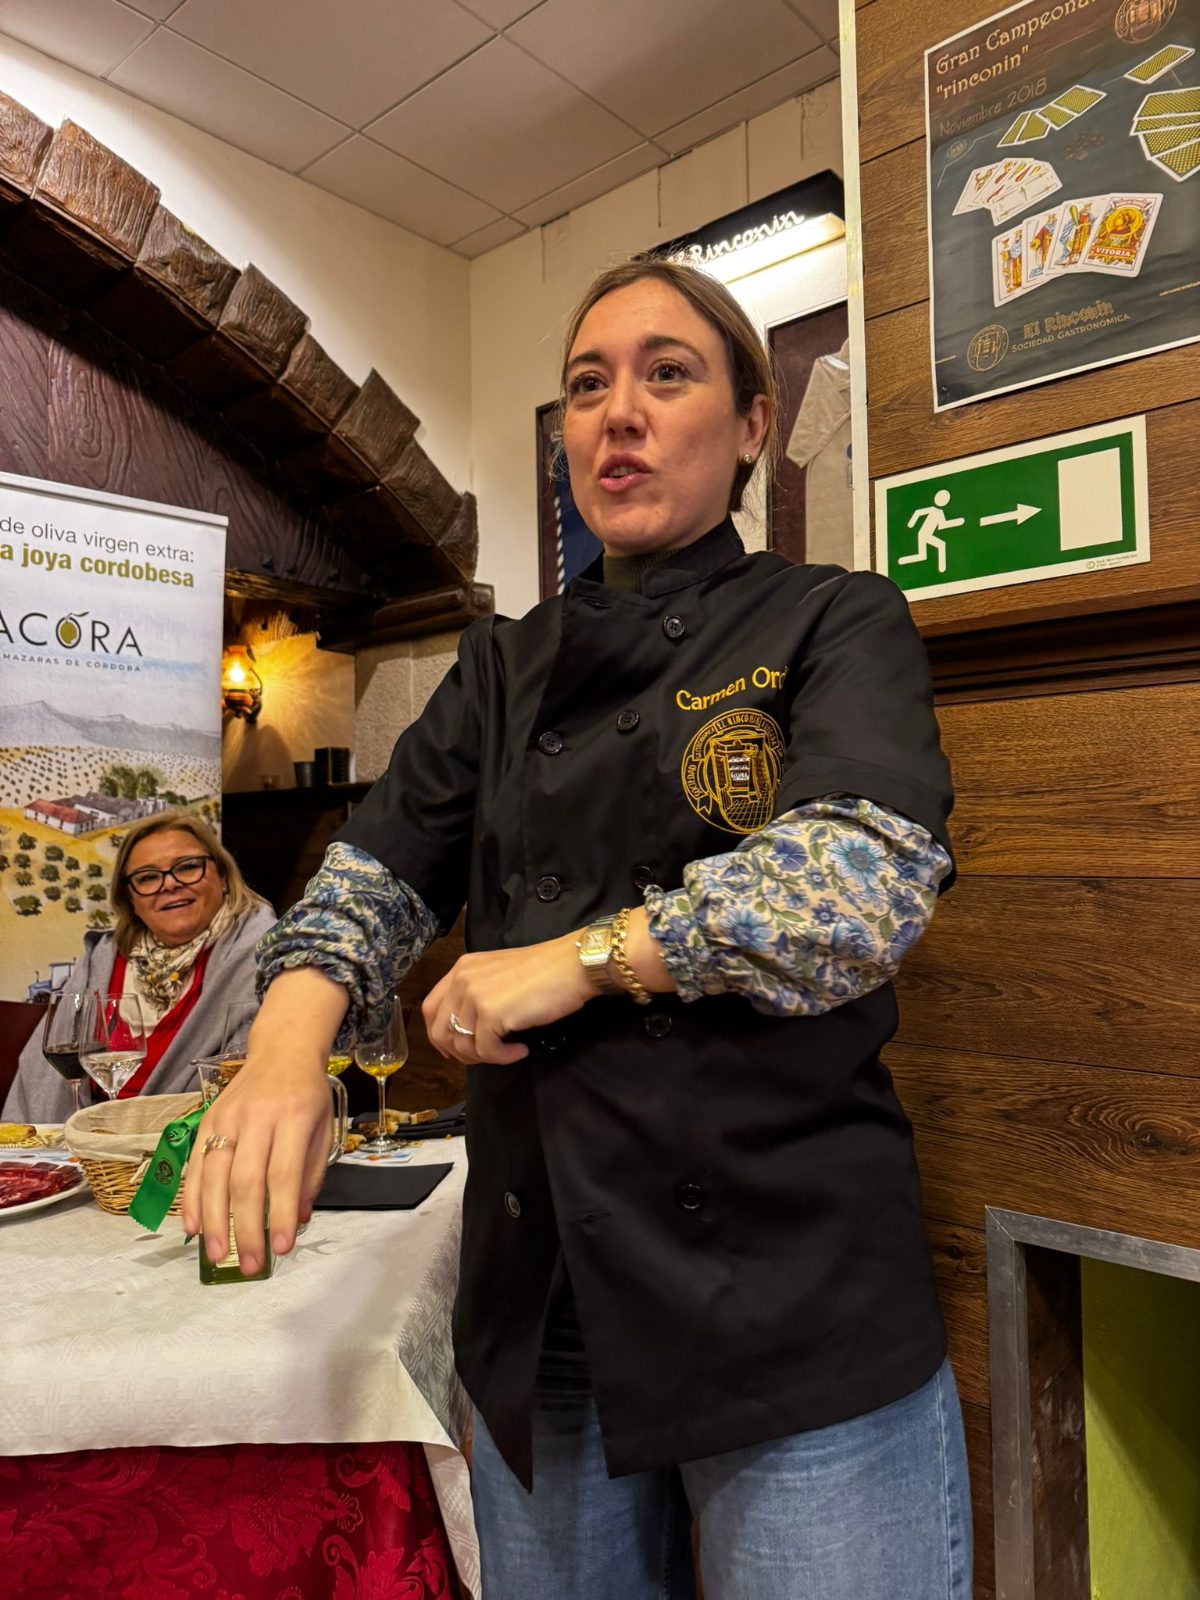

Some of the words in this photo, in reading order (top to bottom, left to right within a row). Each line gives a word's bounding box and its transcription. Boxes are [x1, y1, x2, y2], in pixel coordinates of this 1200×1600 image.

[936, 46, 980, 75] Gran
[986, 0, 1096, 51] Campeona
[936, 44, 1029, 99] "rinconin"
[939, 102, 1002, 137] Noviembre
[1007, 77, 1047, 108] 2018
[1095, 246, 1131, 257] VITORIA
[1011, 334, 1054, 353] SOCIEDAD
[0, 516, 24, 535] de
[31, 523, 77, 544] oliva
[83, 531, 139, 554] virgen
[145, 543, 194, 563] extra:
[21, 542, 72, 572] joya
[80, 556, 194, 588] cordobesa
[65, 659, 81, 667] DE
[676, 677, 746, 711] Carmen
